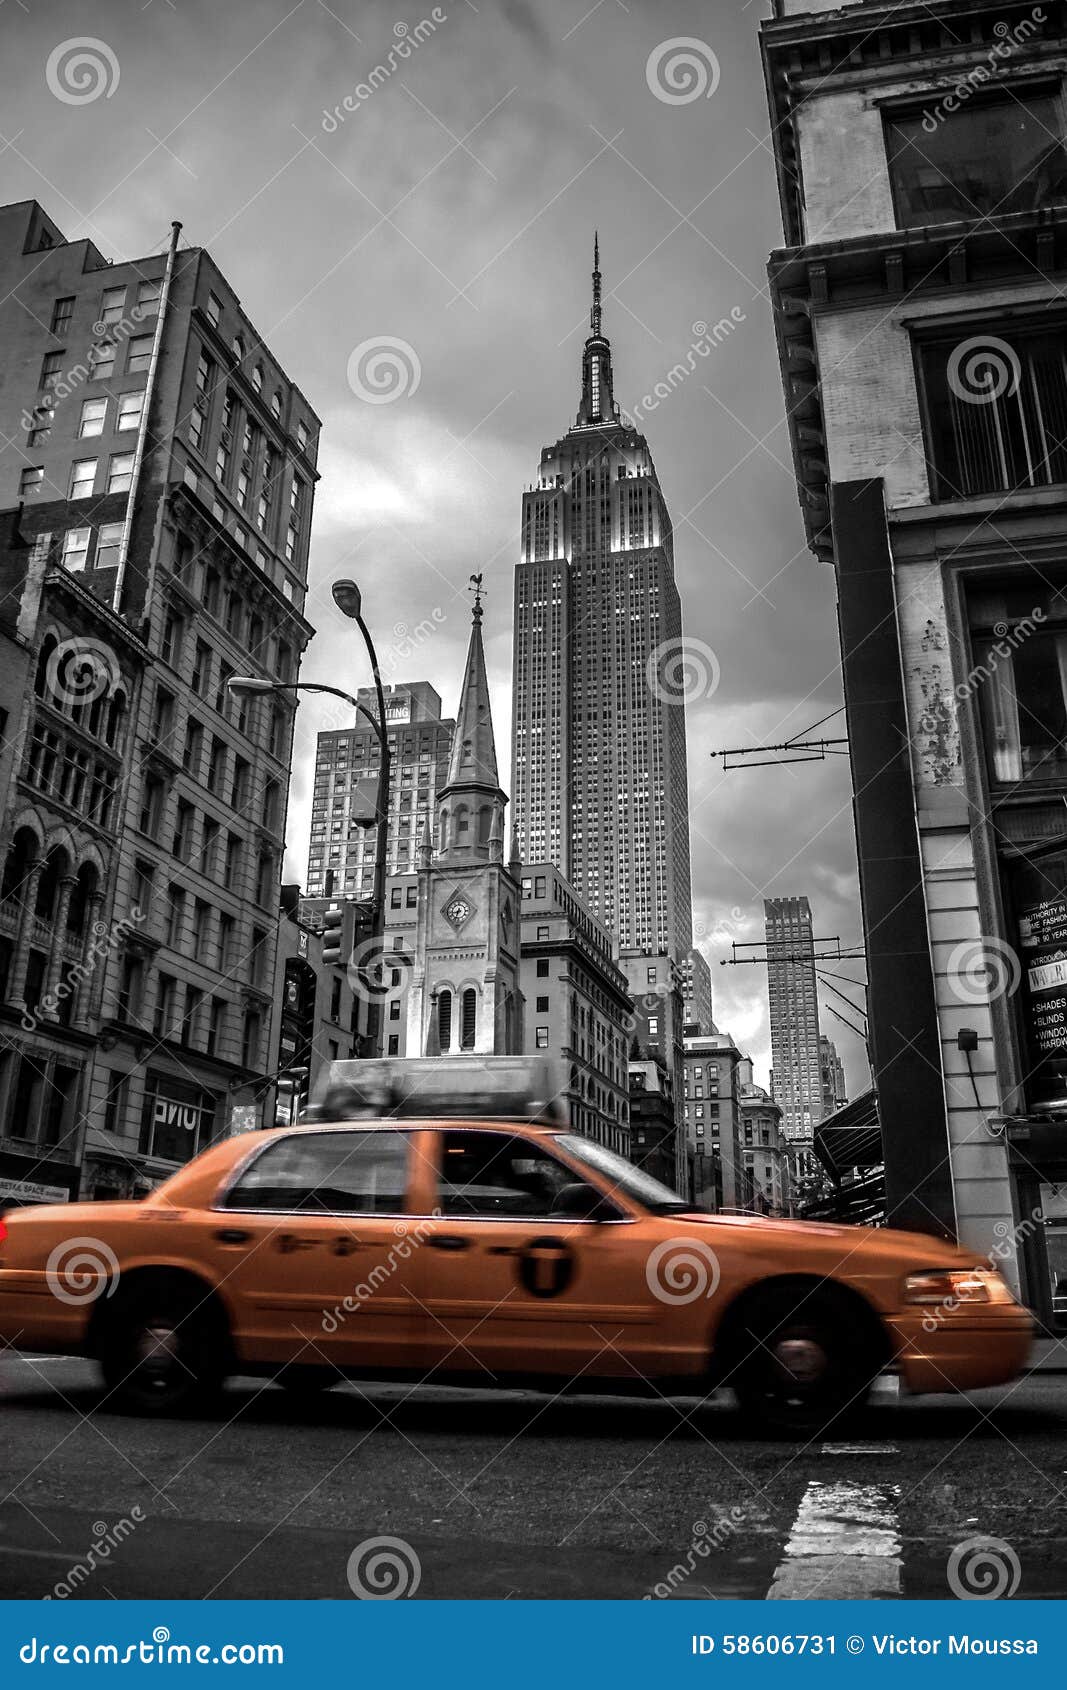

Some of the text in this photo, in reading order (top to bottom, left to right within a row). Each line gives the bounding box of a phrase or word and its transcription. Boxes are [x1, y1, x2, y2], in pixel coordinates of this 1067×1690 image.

[371, 707, 409, 720] RETING
[1036, 998, 1067, 1012] SHADES
[1037, 1013, 1065, 1026] BLINDS
